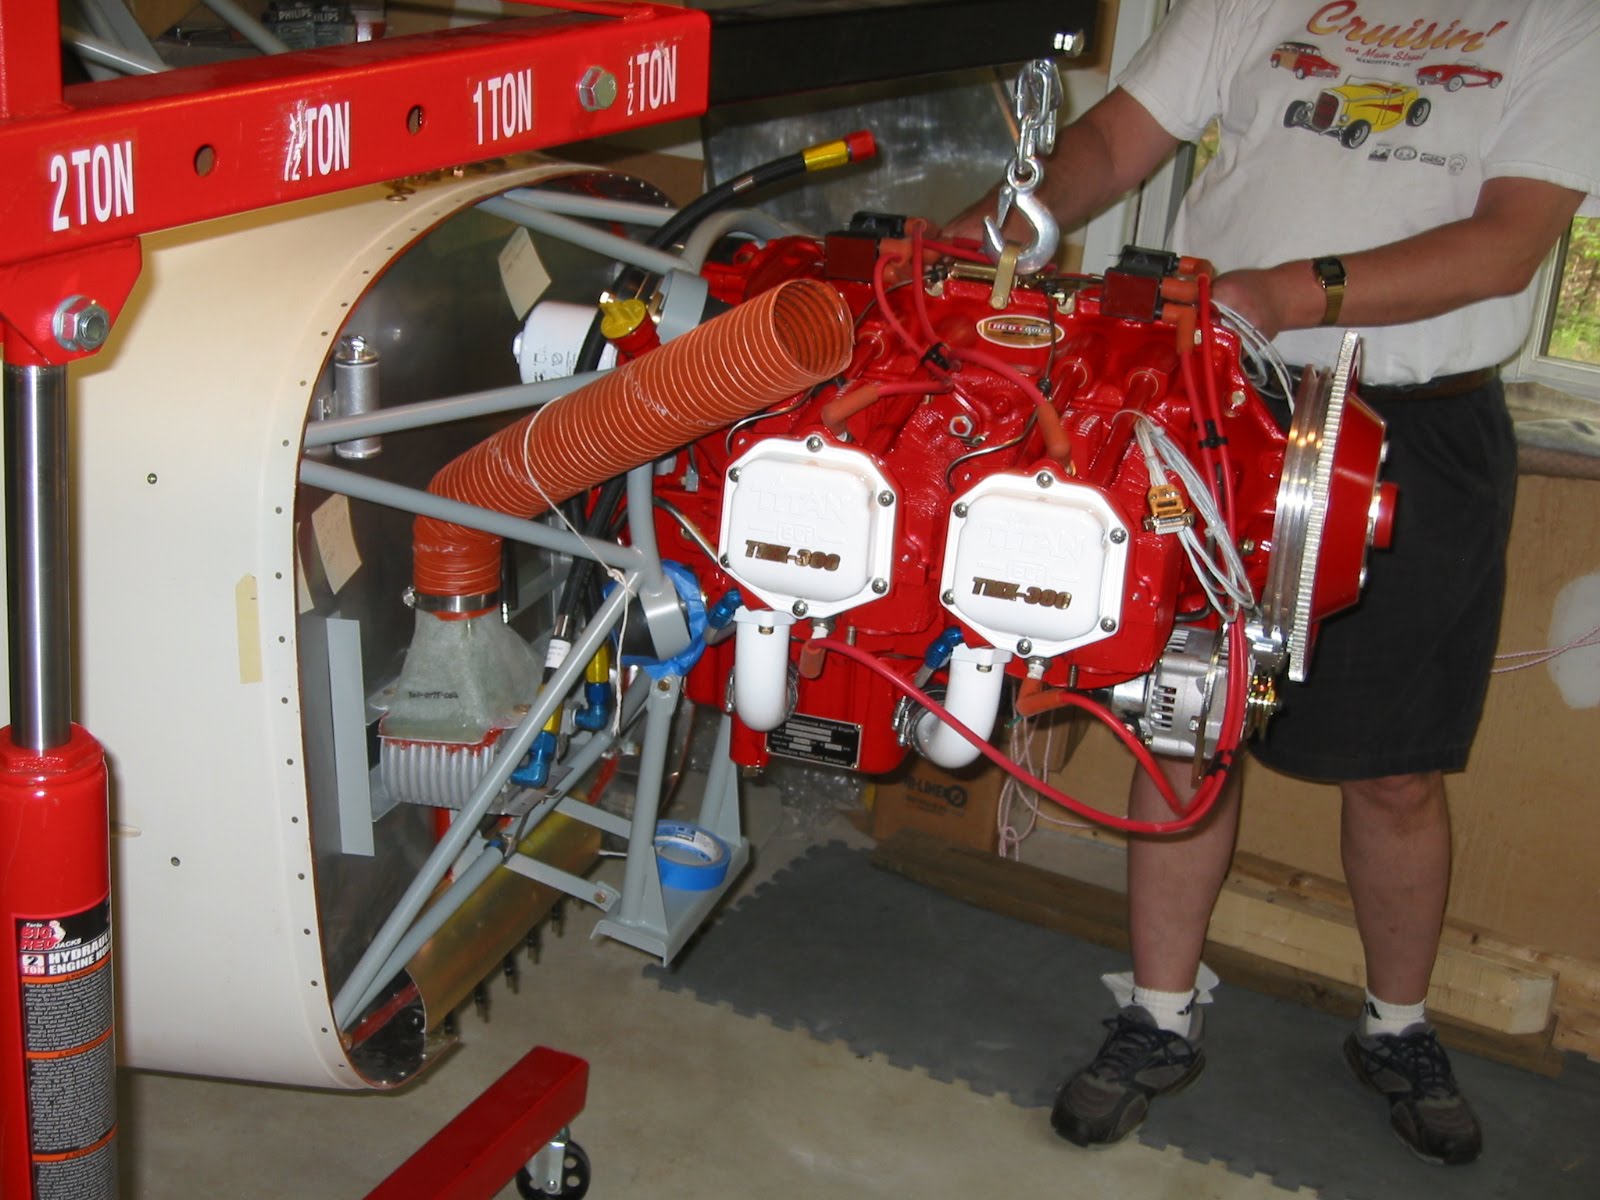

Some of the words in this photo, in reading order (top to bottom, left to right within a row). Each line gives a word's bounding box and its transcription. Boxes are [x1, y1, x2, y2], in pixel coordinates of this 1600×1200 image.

[1306, 0, 1508, 52] Cruisin'
[1362, 48, 1391, 60] Main
[636, 45, 677, 112] TON
[473, 81, 483, 145] 1
[487, 68, 532, 141] TON
[305, 101, 350, 178] TON
[50, 154, 70, 232] 2
[71, 140, 135, 226] TON
[21, 926, 53, 939] BIG
[21, 938, 58, 951] RED
[23, 965, 45, 975] TON
[27, 955, 39, 966] 2
[49, 956, 95, 975] ENGINE
